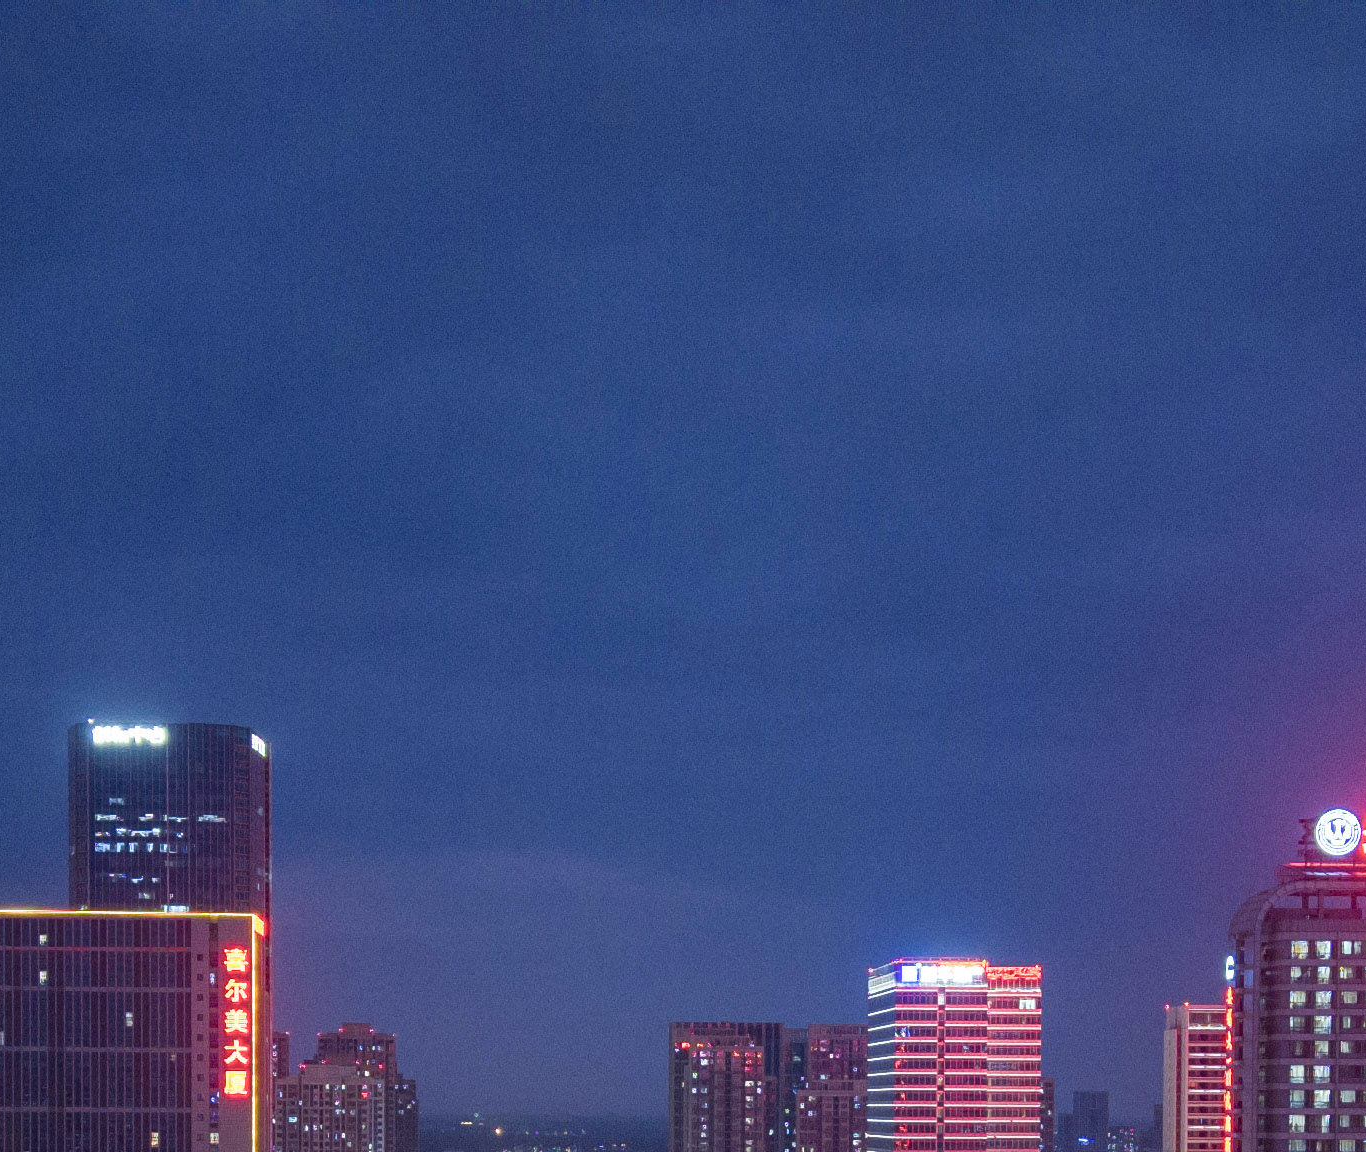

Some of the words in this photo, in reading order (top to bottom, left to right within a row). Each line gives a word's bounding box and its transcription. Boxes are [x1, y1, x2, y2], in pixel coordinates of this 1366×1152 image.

[223, 948, 249, 1095] 喜尔美大厦
